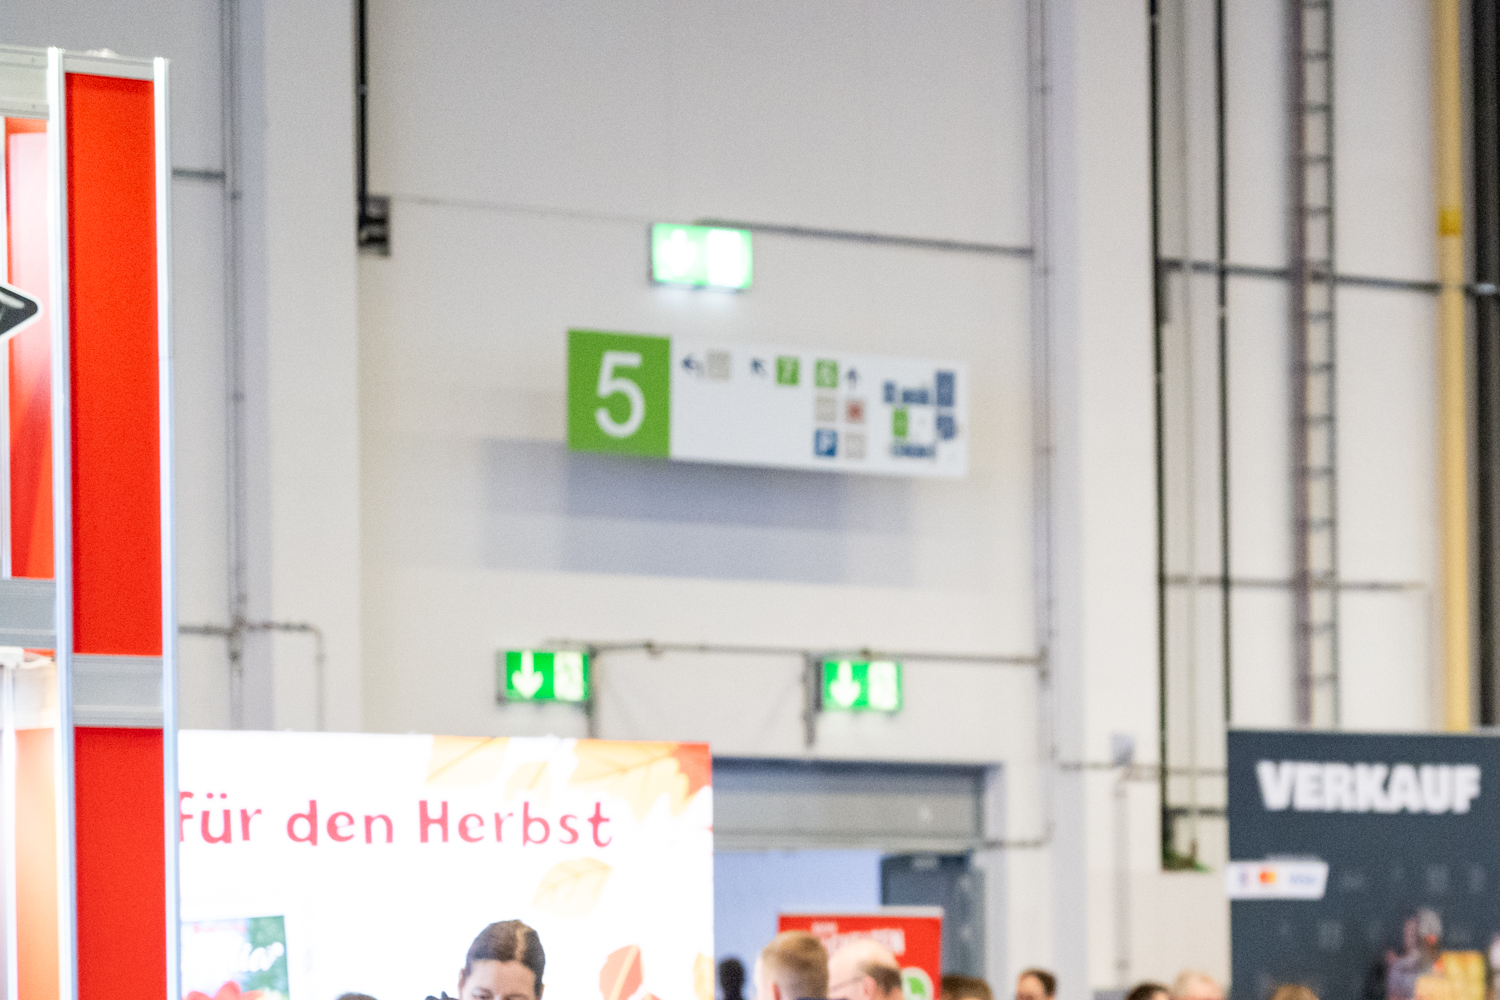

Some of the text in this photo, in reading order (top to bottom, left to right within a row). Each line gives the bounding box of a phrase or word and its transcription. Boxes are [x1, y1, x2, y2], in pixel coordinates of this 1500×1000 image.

[594, 350, 645, 438] 5
[1256, 760, 1481, 814] VERKAUF
[178, 790, 613, 847] für den Herbst
